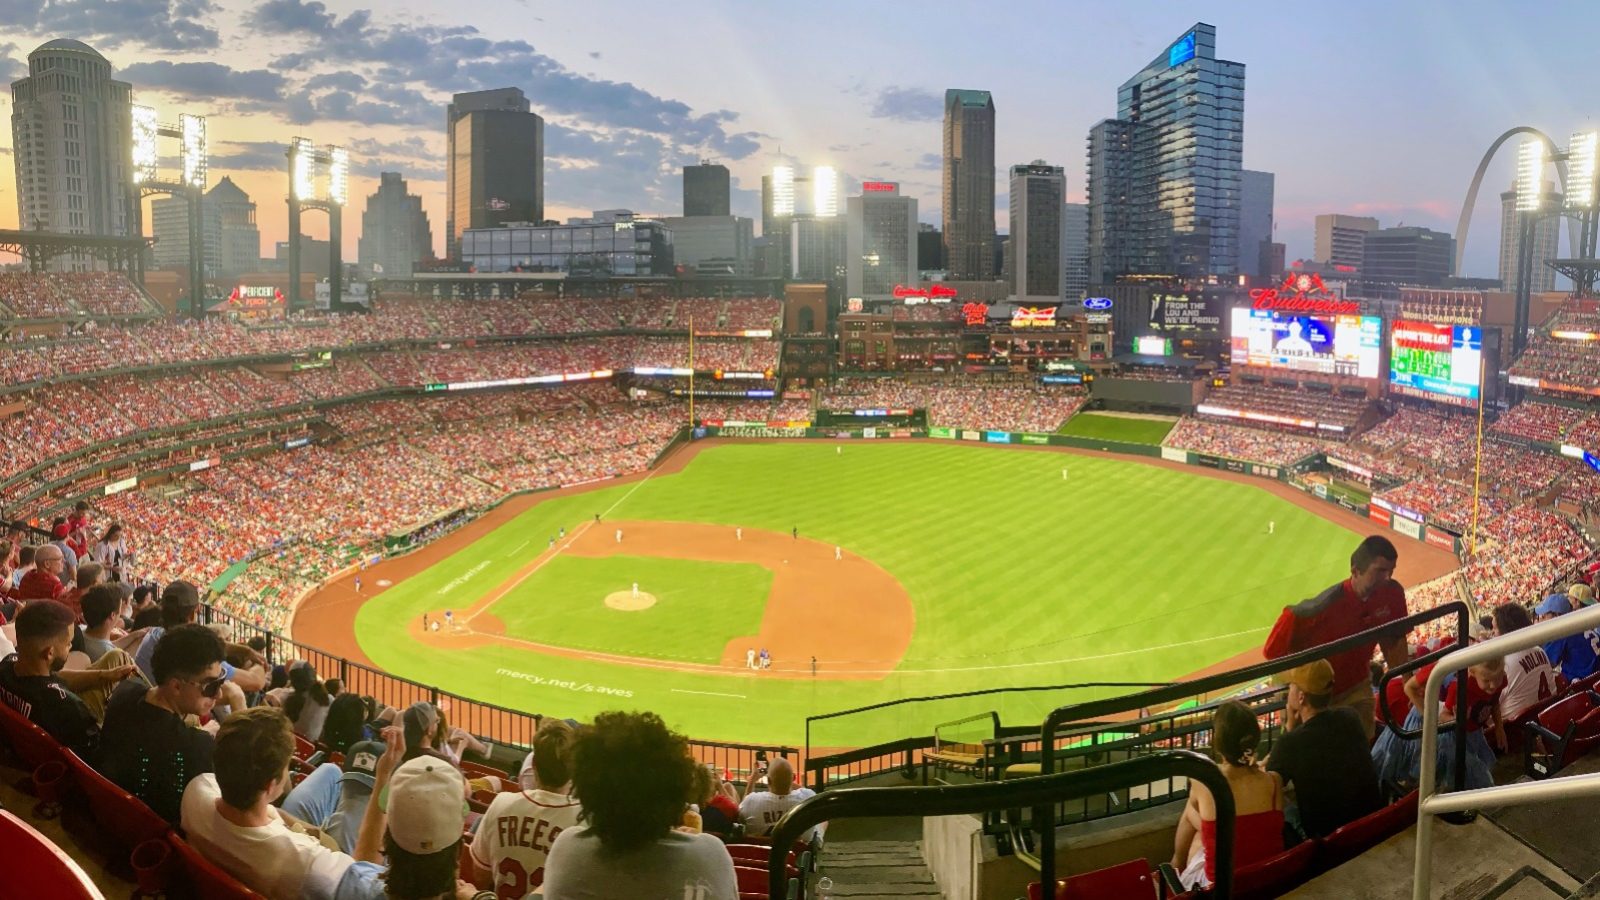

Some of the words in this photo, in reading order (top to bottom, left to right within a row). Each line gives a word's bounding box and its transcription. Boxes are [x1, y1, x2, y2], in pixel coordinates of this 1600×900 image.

[1088, 298, 1107, 307] Ford
[1190, 302, 1206, 310] THE
[1249, 288, 1360, 313] Budweiser
[1538, 671, 1552, 701] 4
